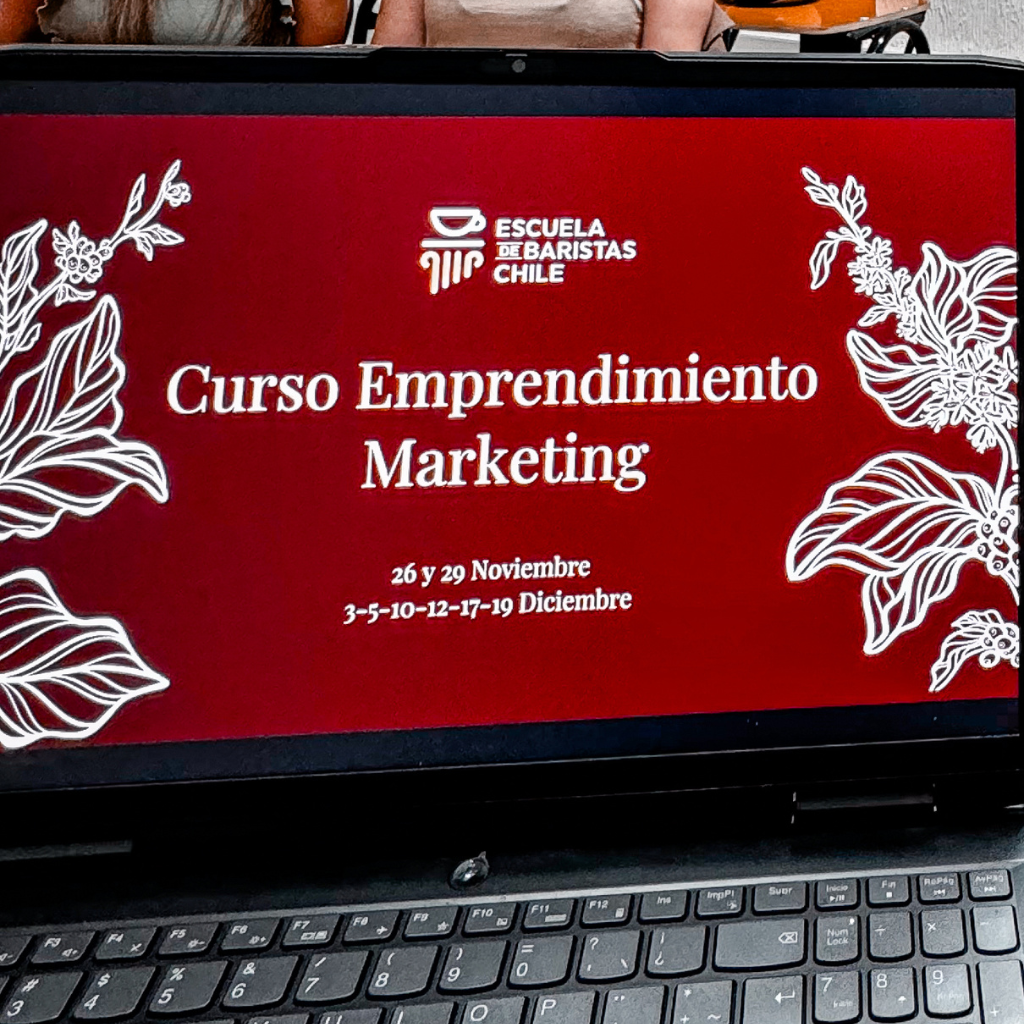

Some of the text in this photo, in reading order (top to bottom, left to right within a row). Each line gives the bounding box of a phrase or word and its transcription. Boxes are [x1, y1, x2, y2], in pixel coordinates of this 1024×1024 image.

[494, 217, 606, 239] ESCUELA
[498, 240, 637, 261] DE BARISTAS
[493, 263, 566, 284] CHILE
[166, 352, 818, 419] Curso Emprendimiento
[360, 431, 650, 492] Marketing
[390, 554, 591, 588] 26 y 29 Noviembre
[343, 587, 633, 625] 3-5-10-12-17-19 Diciembre
[530, 904, 550, 914] F11
[589, 899, 609, 910] F12
[413, 912, 429, 922] F9
[472, 908, 494, 918] F10
[231, 924, 248, 935] F6
[292, 920, 311, 931] F7
[826, 928, 849, 937] Num
[107, 933, 124, 944] F4
[169, 929, 187, 939] F5
[826, 936, 849, 946] Lock
[44, 937, 62, 948] F3
[97, 973, 111, 988] $
[374, 972, 390, 988] 8
[447, 966, 461, 982] 9
[876, 972, 888, 989] 8
[932, 969, 944, 986] 9
[21, 978, 39, 993] #
[231, 982, 247, 999] 6
[304, 977, 320, 993] 7
[821, 976, 833, 993] 7
[83, 994, 100, 1011] 4
[157, 988, 175, 1005] 5
[6, 1000, 25, 1017] 3
[470, 1004, 489, 1022] O
[540, 999, 557, 1016] P
